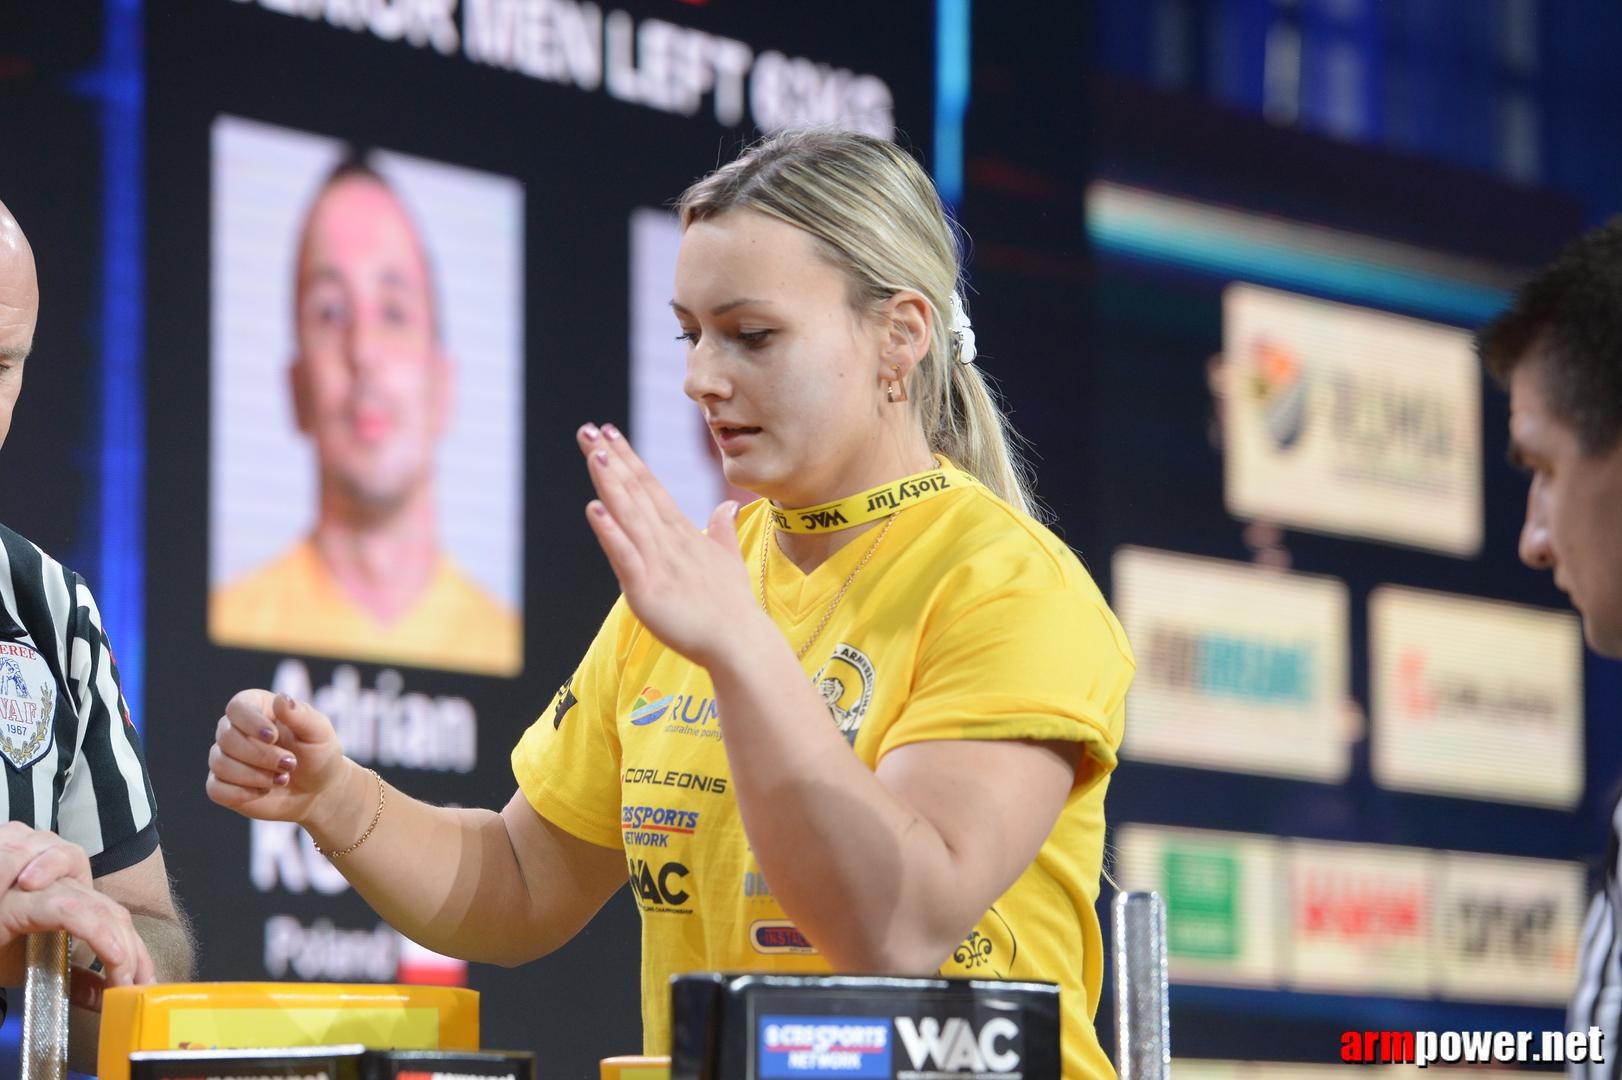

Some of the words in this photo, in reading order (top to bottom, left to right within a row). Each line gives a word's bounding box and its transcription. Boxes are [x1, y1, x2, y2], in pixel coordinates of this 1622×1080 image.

[461, 0, 602, 91] MEN
[605, 9, 753, 127] LEFT
[801, 509, 849, 530] WAC
[6, 724, 27, 736] 1967
[271, 658, 478, 774] Adrian
[625, 768, 728, 794] CORLEONIS
[264, 913, 396, 980] Poland
[788, 1051, 862, 1070] NETWORK
[894, 1016, 1020, 1072] WAC
